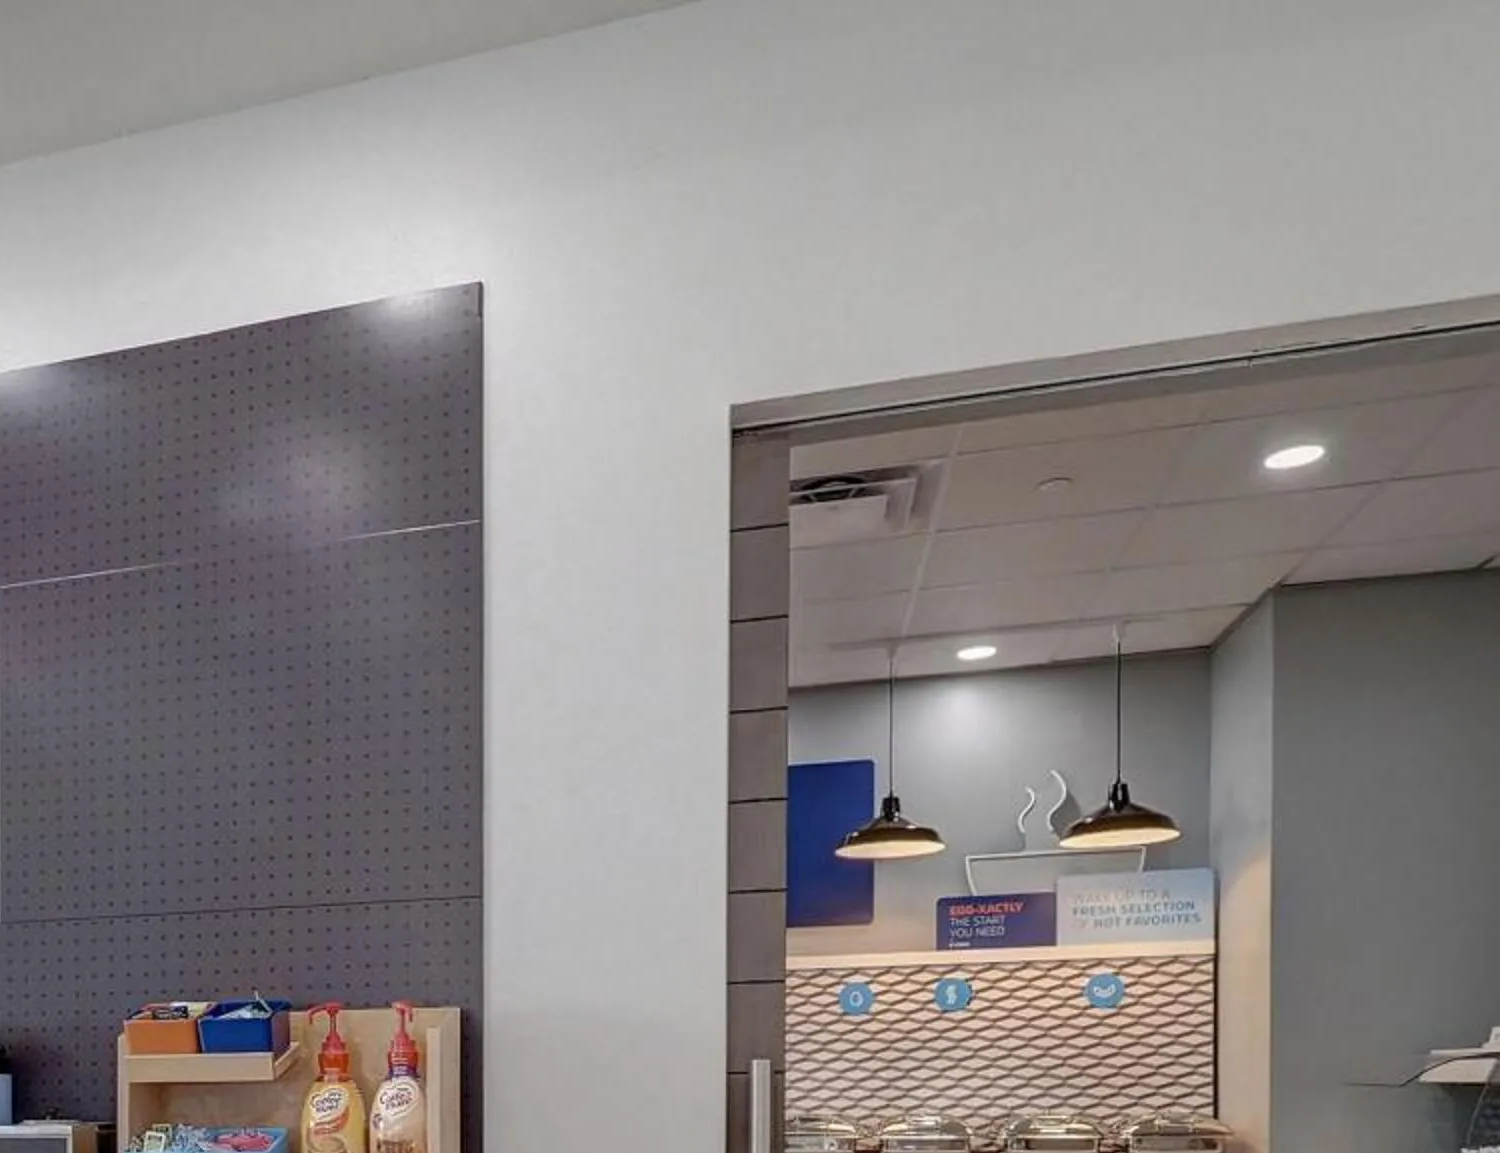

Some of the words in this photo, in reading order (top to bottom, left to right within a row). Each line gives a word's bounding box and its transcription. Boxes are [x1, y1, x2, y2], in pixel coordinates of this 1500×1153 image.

[1071, 904, 1116, 917] FRESH
[1120, 900, 1196, 915] SELECTION
[951, 917, 970, 927] THE
[974, 914, 1005, 926] START
[1093, 916, 1121, 929] HOT
[1124, 912, 1202, 926] FAVORITES
[951, 927, 972, 938] YOU
[975, 926, 1005, 937] NEED
